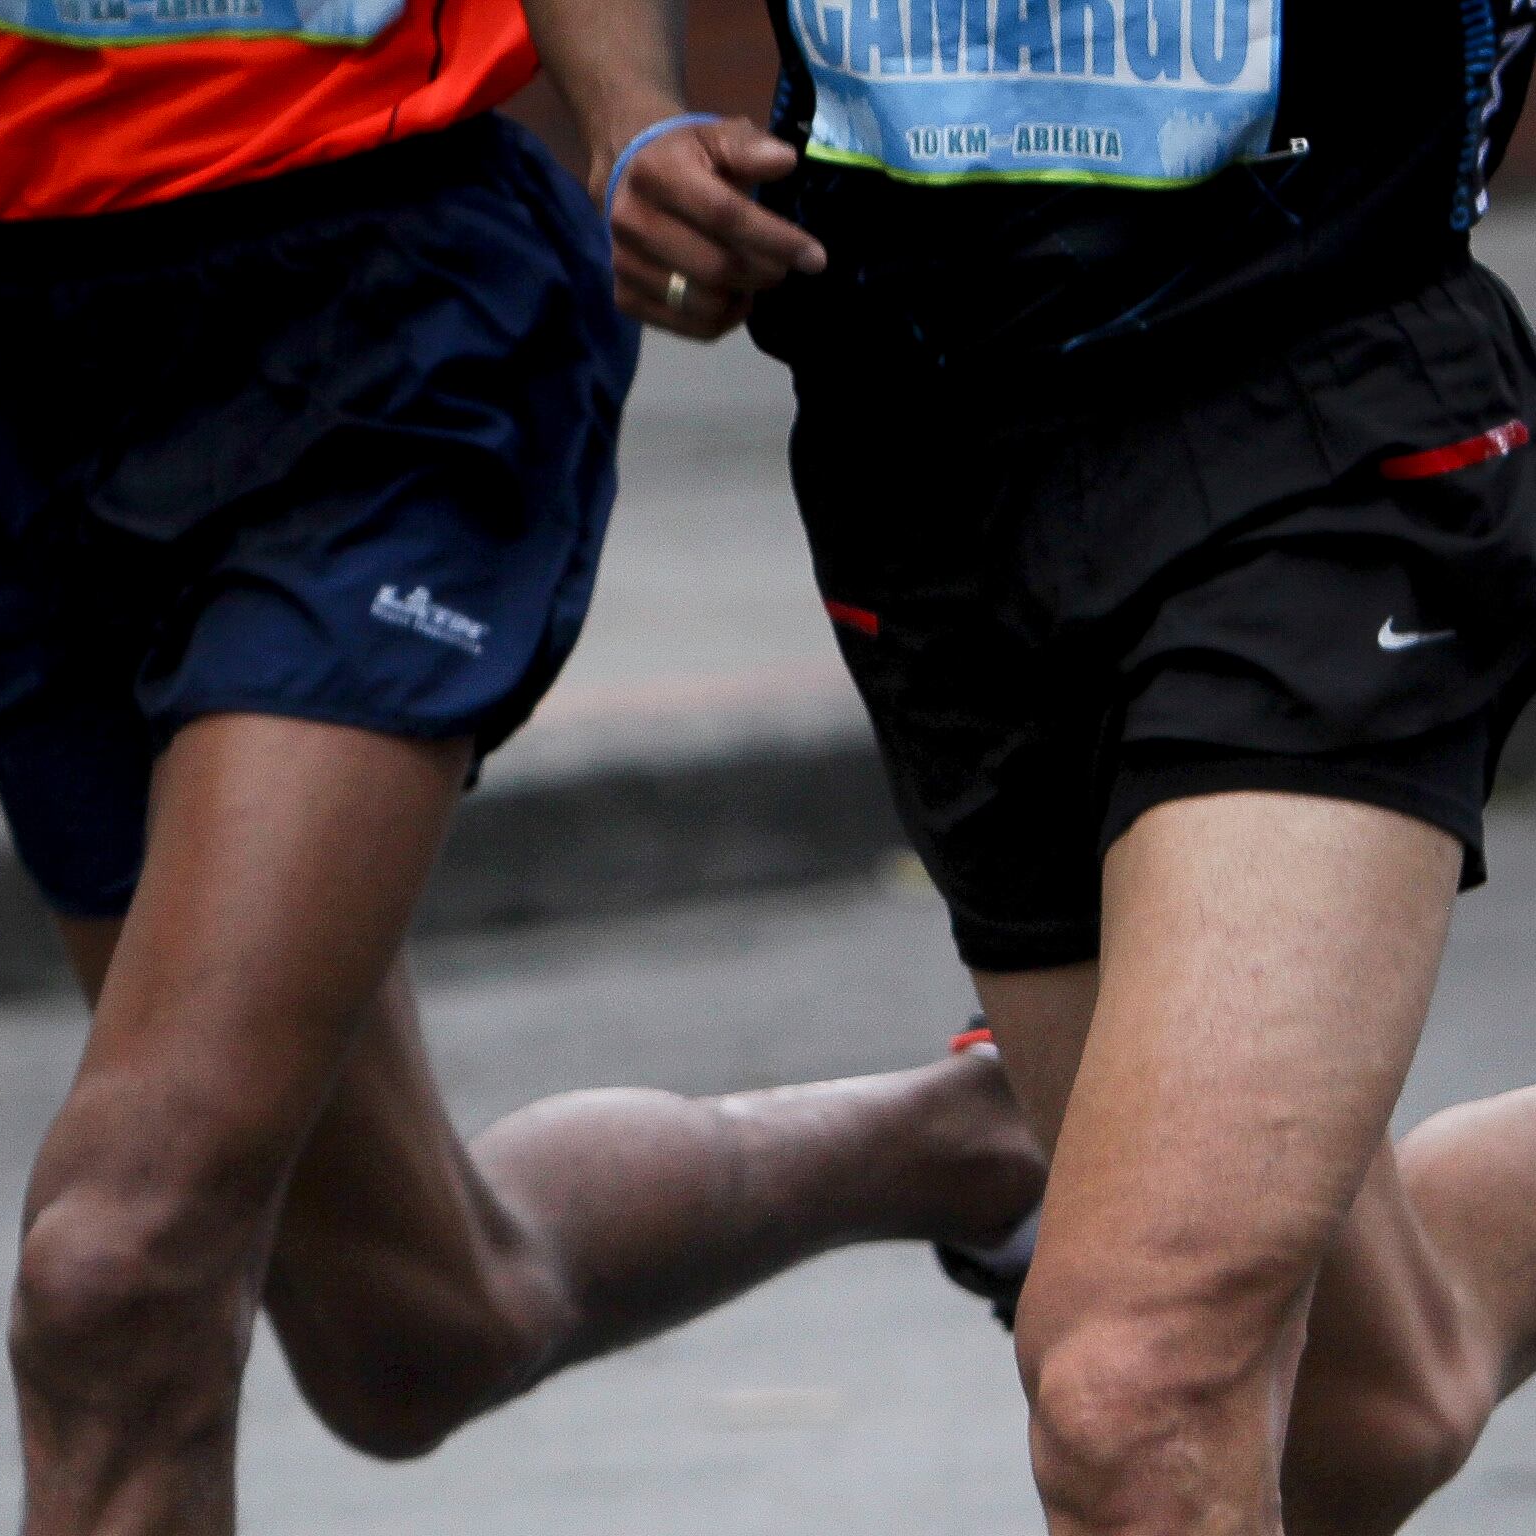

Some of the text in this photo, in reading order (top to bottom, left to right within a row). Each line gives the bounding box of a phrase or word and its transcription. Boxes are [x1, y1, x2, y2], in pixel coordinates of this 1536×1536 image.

[792, 0, 1250, 85] CAMARGO
[908, 126, 938, 156] 10
[946, 125, 988, 155] KM
[1015, 124, 1121, 158] ABIERTA
